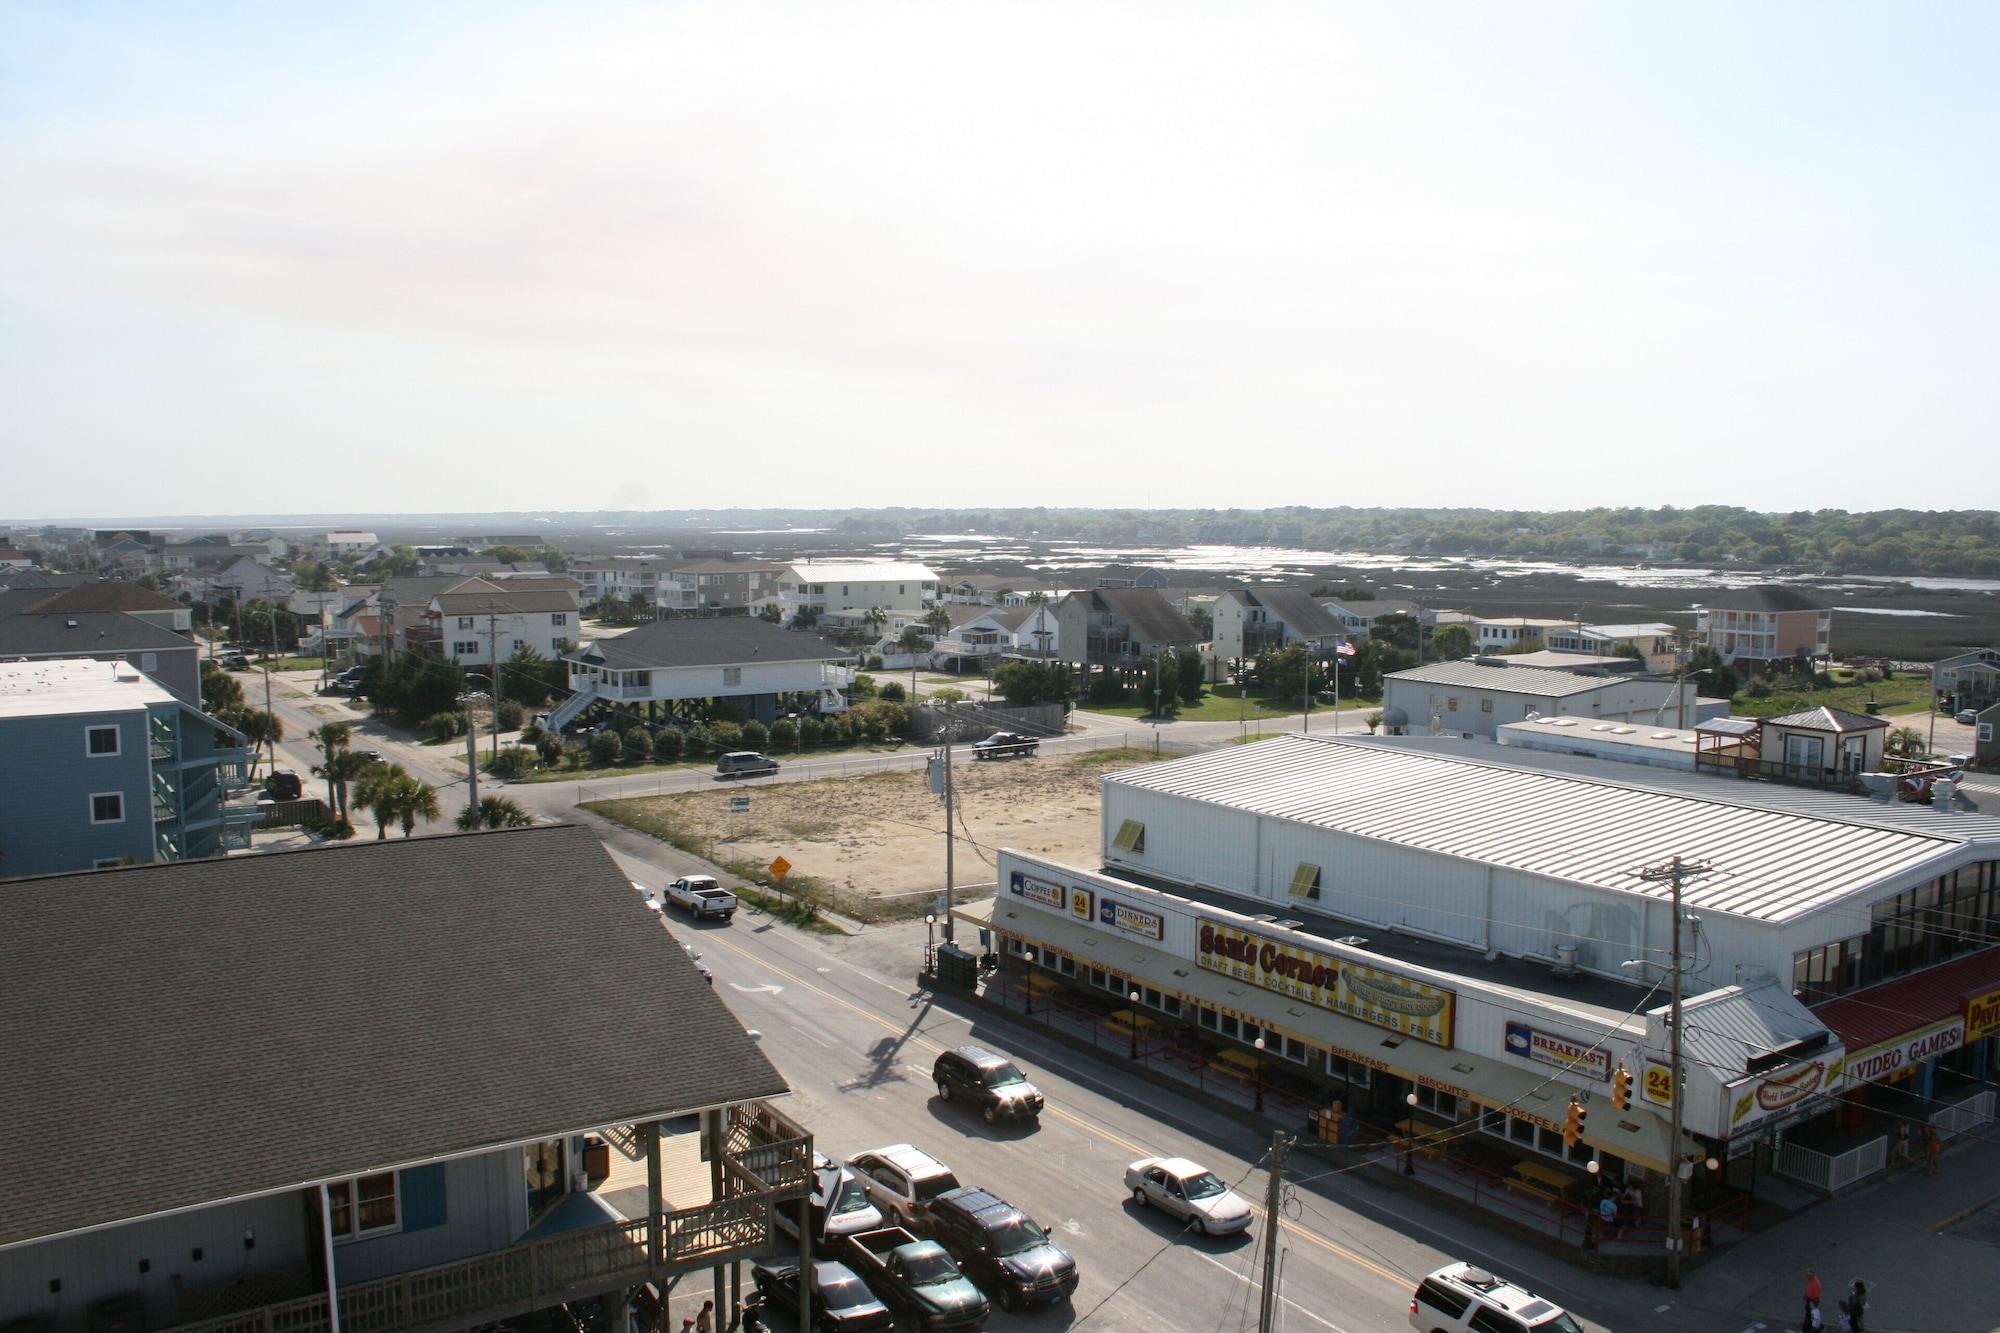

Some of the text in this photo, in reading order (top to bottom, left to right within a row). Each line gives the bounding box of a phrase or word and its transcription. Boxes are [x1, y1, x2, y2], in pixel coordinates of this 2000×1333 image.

[1074, 895, 1086, 908] 24
[1117, 907, 1158, 928] DINNERS
[1200, 925, 1258, 966] Sam's
[1259, 943, 1339, 990] Corner
[1200, 955, 1228, 976] DRAFT
[1232, 963, 1256, 982] BEER
[1264, 971, 1317, 1002] COCKTAILS
[1326, 996, 1399, 1028] HAMBURGERS
[1410, 1023, 1442, 1043] FRIES
[1221, 1006, 1275, 1031] CORNER
[1331, 1045, 1392, 1073] BREAKFAST
[1532, 1035, 1606, 1066] BREAKFAST
[1856, 1048, 1902, 1079] VIDEO
[1908, 1027, 1958, 1061] GAMES
[1418, 1075, 1470, 1098] BISCUITS
[1648, 1071, 1671, 1090] 24
